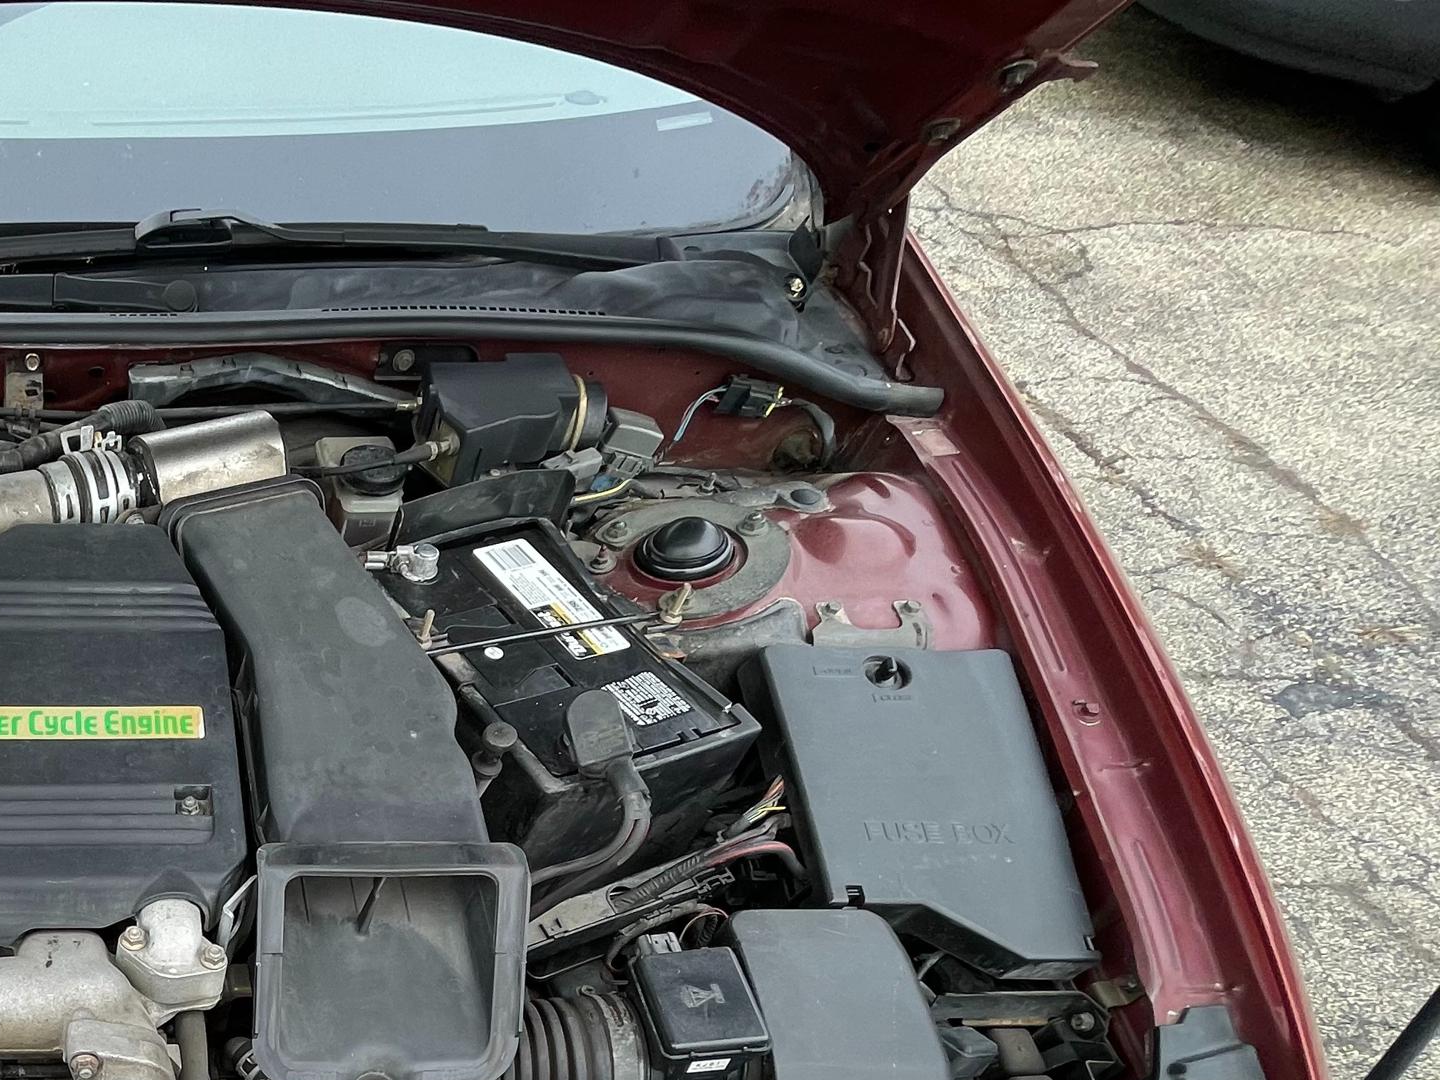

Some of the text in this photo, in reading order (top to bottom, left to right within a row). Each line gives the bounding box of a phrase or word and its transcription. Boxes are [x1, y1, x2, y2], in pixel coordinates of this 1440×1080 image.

[28, 709, 98, 736] Cycle
[104, 709, 194, 735] Engine
[863, 821, 1016, 844] FUSE BOX
